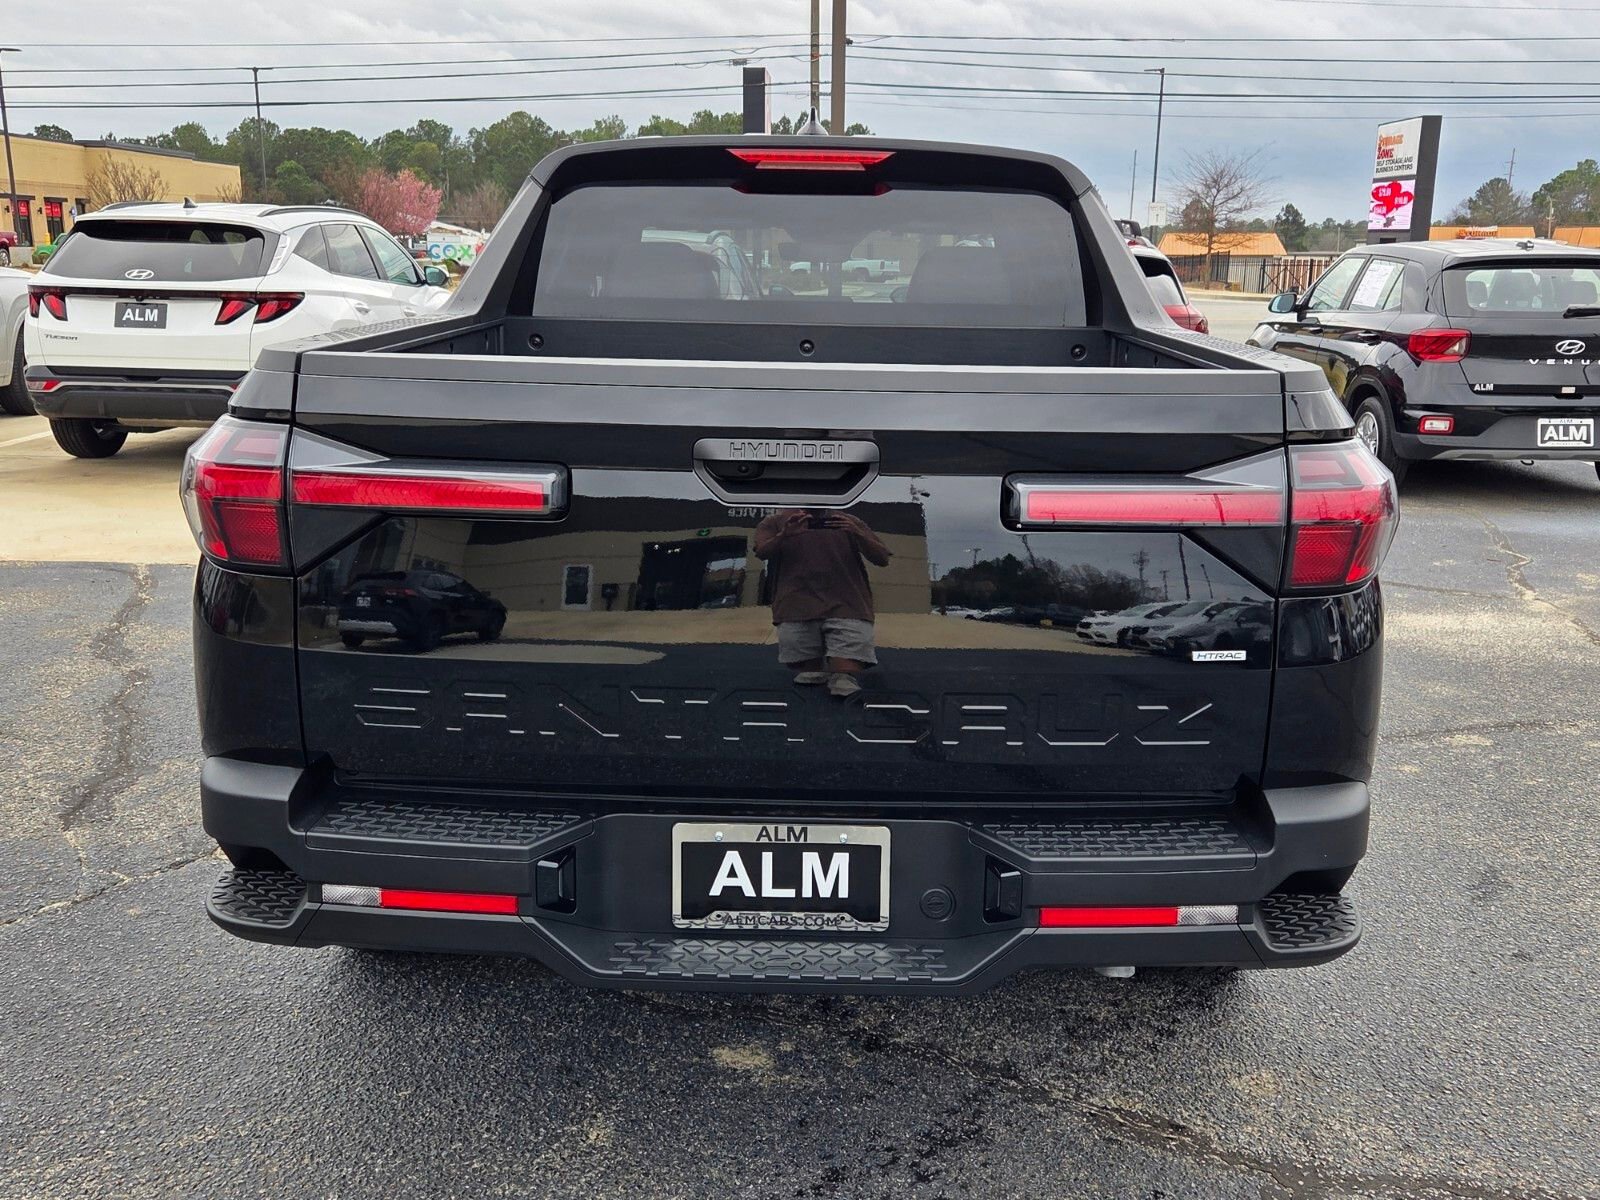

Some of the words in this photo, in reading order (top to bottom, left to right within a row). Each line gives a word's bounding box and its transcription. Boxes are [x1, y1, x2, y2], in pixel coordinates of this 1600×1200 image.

[429, 243, 475, 260] COX
[122, 308, 158, 322] ALM
[1474, 383, 1494, 391] ALM
[1543, 425, 1587, 441] ALM
[729, 442, 843, 460] HYUNDAI
[1196, 652, 1243, 660] HTRAC
[353, 676, 805, 742] SANTA
[846, 691, 1213, 747] CRUZ
[755, 825, 808, 842] ALM
[708, 850, 850, 899] ALM
[724, 913, 838, 928] ALMCARS.COM
